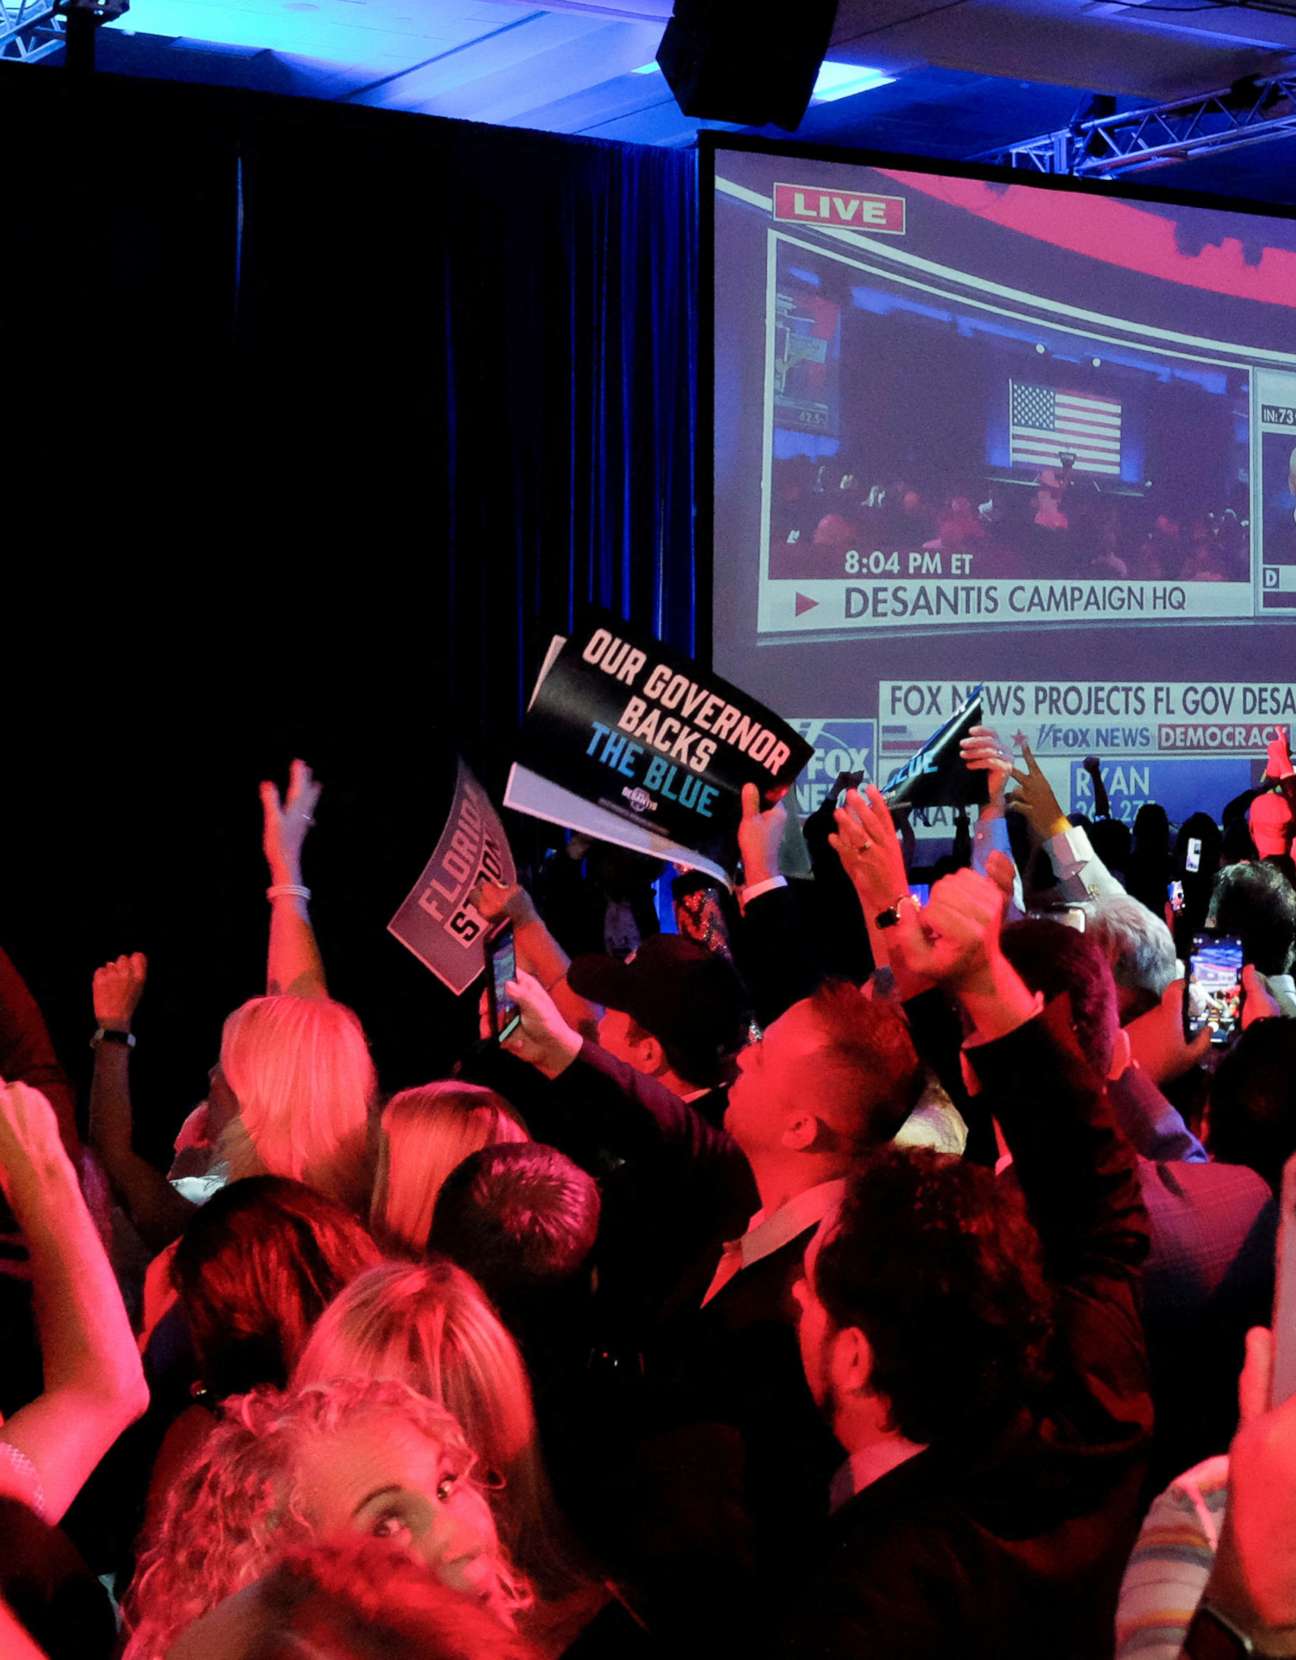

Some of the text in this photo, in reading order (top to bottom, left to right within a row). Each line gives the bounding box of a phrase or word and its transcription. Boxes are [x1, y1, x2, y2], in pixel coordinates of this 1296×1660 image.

[794, 192, 887, 225] LIVE
[844, 550, 974, 575] 8:04 PM ET
[1265, 572, 1277, 588] D
[844, 584, 1187, 620] DESANTIS CAMPAIGN HQ
[581, 628, 792, 777] OUR GOVERNOR
[890, 684, 943, 716] FOX
[1034, 684, 1146, 717] PROJECTS
[1154, 685, 1175, 716] FL
[1182, 684, 1237, 716] GOV
[617, 695, 718, 773] BACKS
[1053, 726, 1151, 749] FOX NEWS
[585, 721, 645, 778] THE
[642, 755, 720, 818] BLUE
[807, 747, 869, 780] FOX
